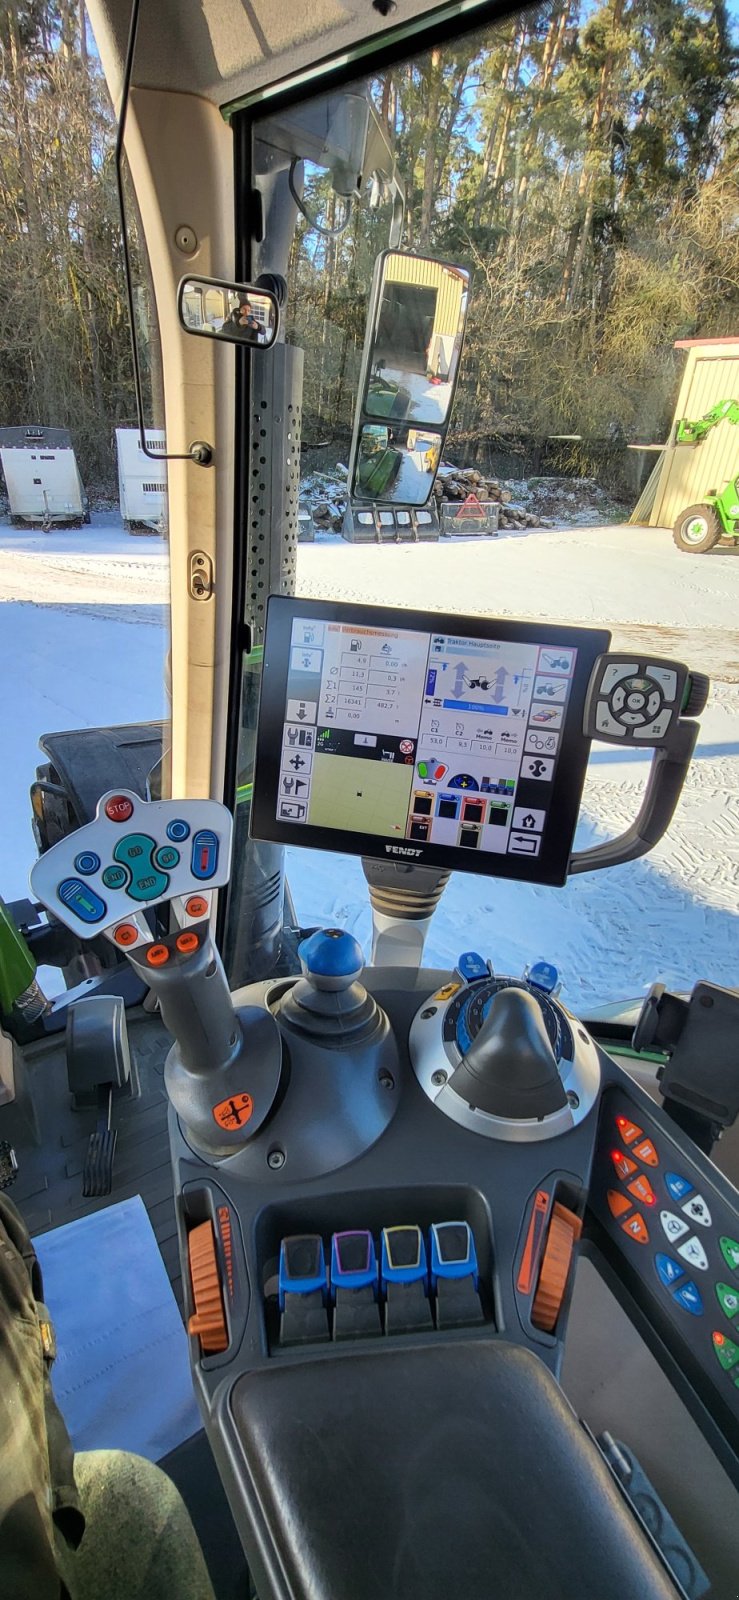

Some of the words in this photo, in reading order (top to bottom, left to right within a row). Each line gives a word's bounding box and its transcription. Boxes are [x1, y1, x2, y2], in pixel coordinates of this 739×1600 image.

[612, 668, 618, 676] ?
[108, 801, 130, 815] STOP
[129, 846, 142, 857] GO
[385, 845, 423, 857] FENDT
[161, 852, 174, 863] GO
[106, 870, 123, 883] END
[139, 876, 156, 890] END
[191, 903, 202, 912] C2
[630, 1221, 641, 1233] N
